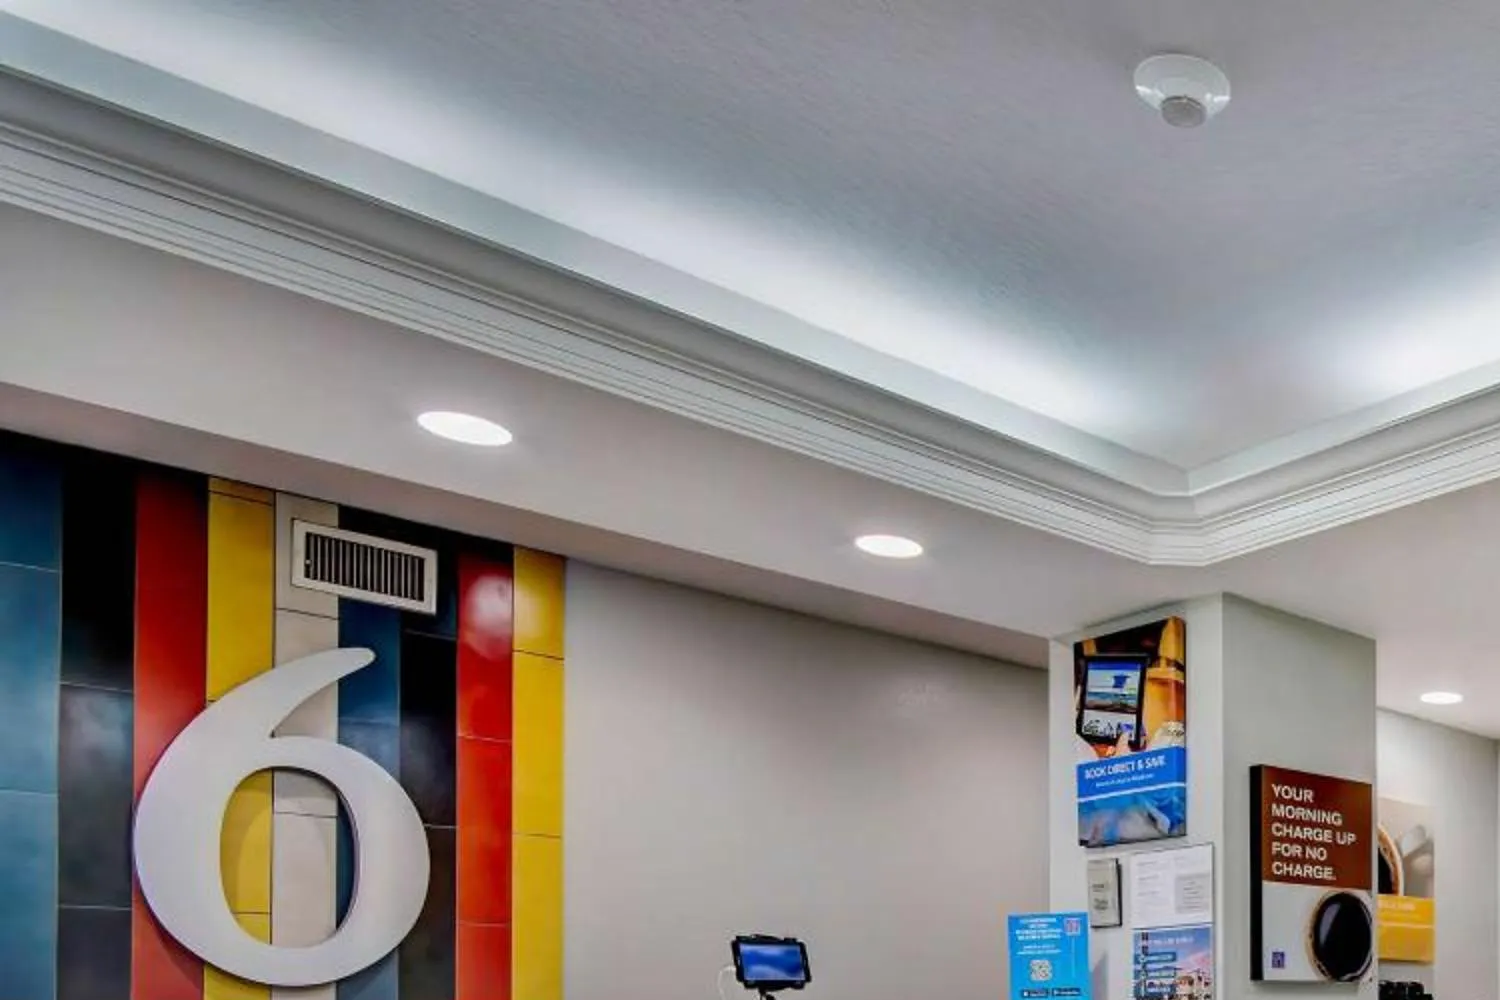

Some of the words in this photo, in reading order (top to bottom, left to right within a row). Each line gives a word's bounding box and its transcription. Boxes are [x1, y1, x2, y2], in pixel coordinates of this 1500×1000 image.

[1084, 767, 1107, 779] BOOK
[1107, 761, 1135, 774] DIRECT
[1145, 755, 1166, 769] SAVE
[1271, 783, 1314, 803] YOUR
[134, 647, 430, 987] 6
[1271, 803, 1343, 827] MORNING
[1271, 822, 1333, 843] CHARGE
[1336, 831, 1357, 845] UP
[1271, 841, 1302, 858] FOR
[1305, 846, 1328, 861] NO
[1271, 861, 1337, 881] CHARGE.
